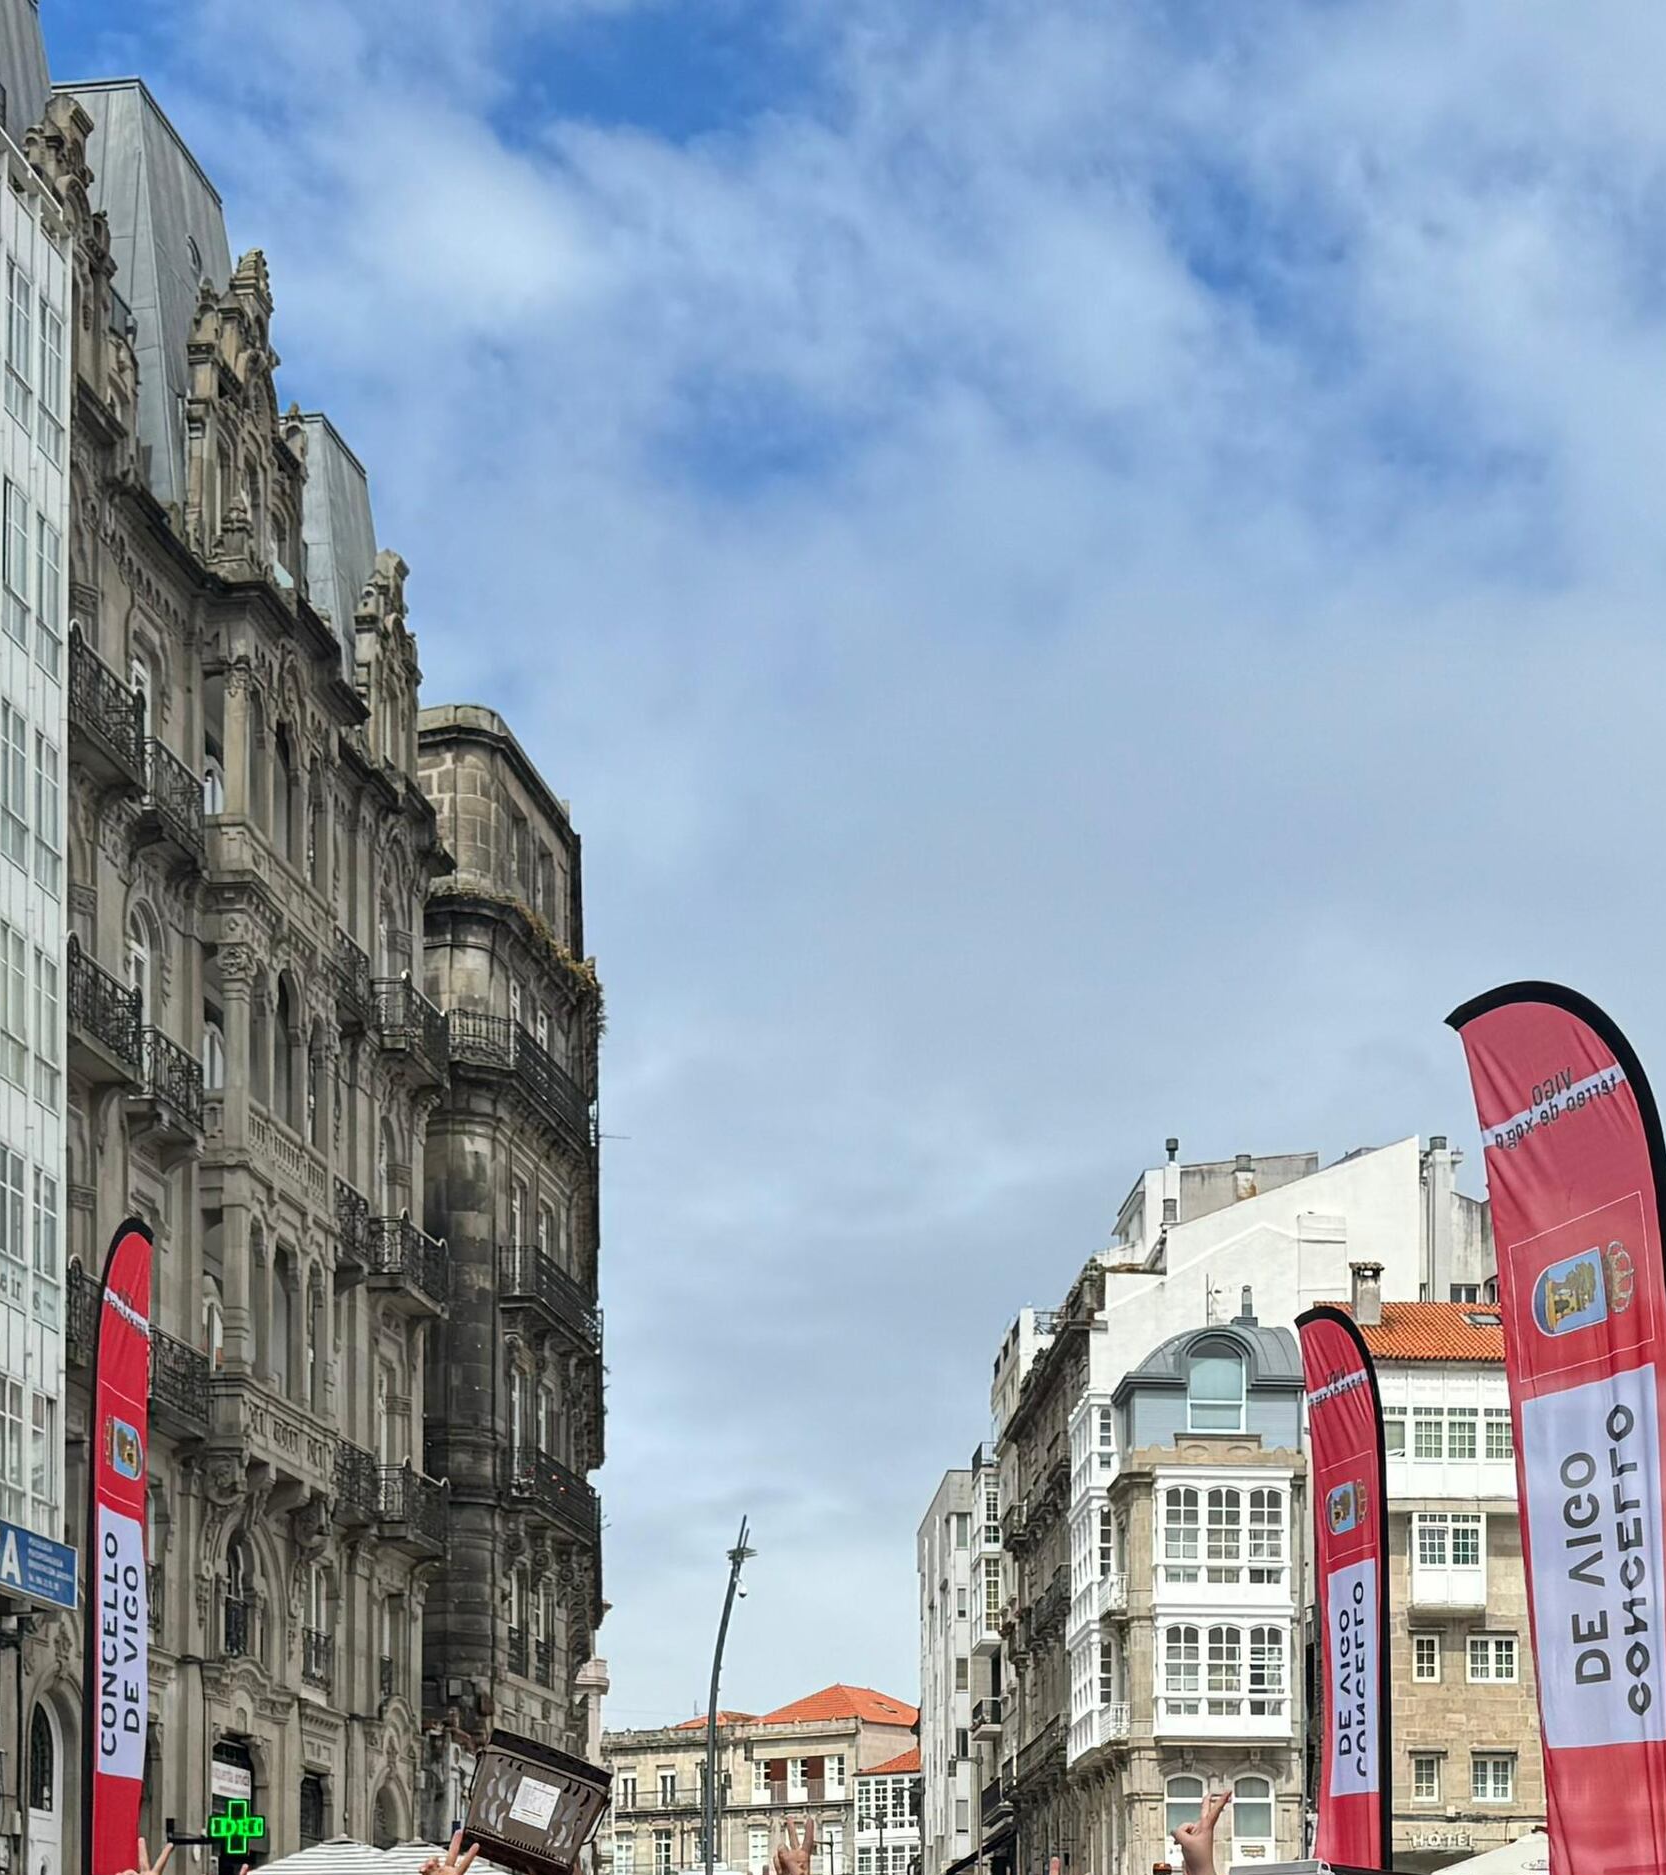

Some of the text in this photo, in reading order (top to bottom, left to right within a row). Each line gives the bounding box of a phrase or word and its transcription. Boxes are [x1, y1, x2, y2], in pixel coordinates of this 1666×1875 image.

[101, 1531, 119, 1757] CONCELLO
[123, 1565, 140, 1734] DE VIGO
[1410, 1832, 1477, 1849] HOTEL
